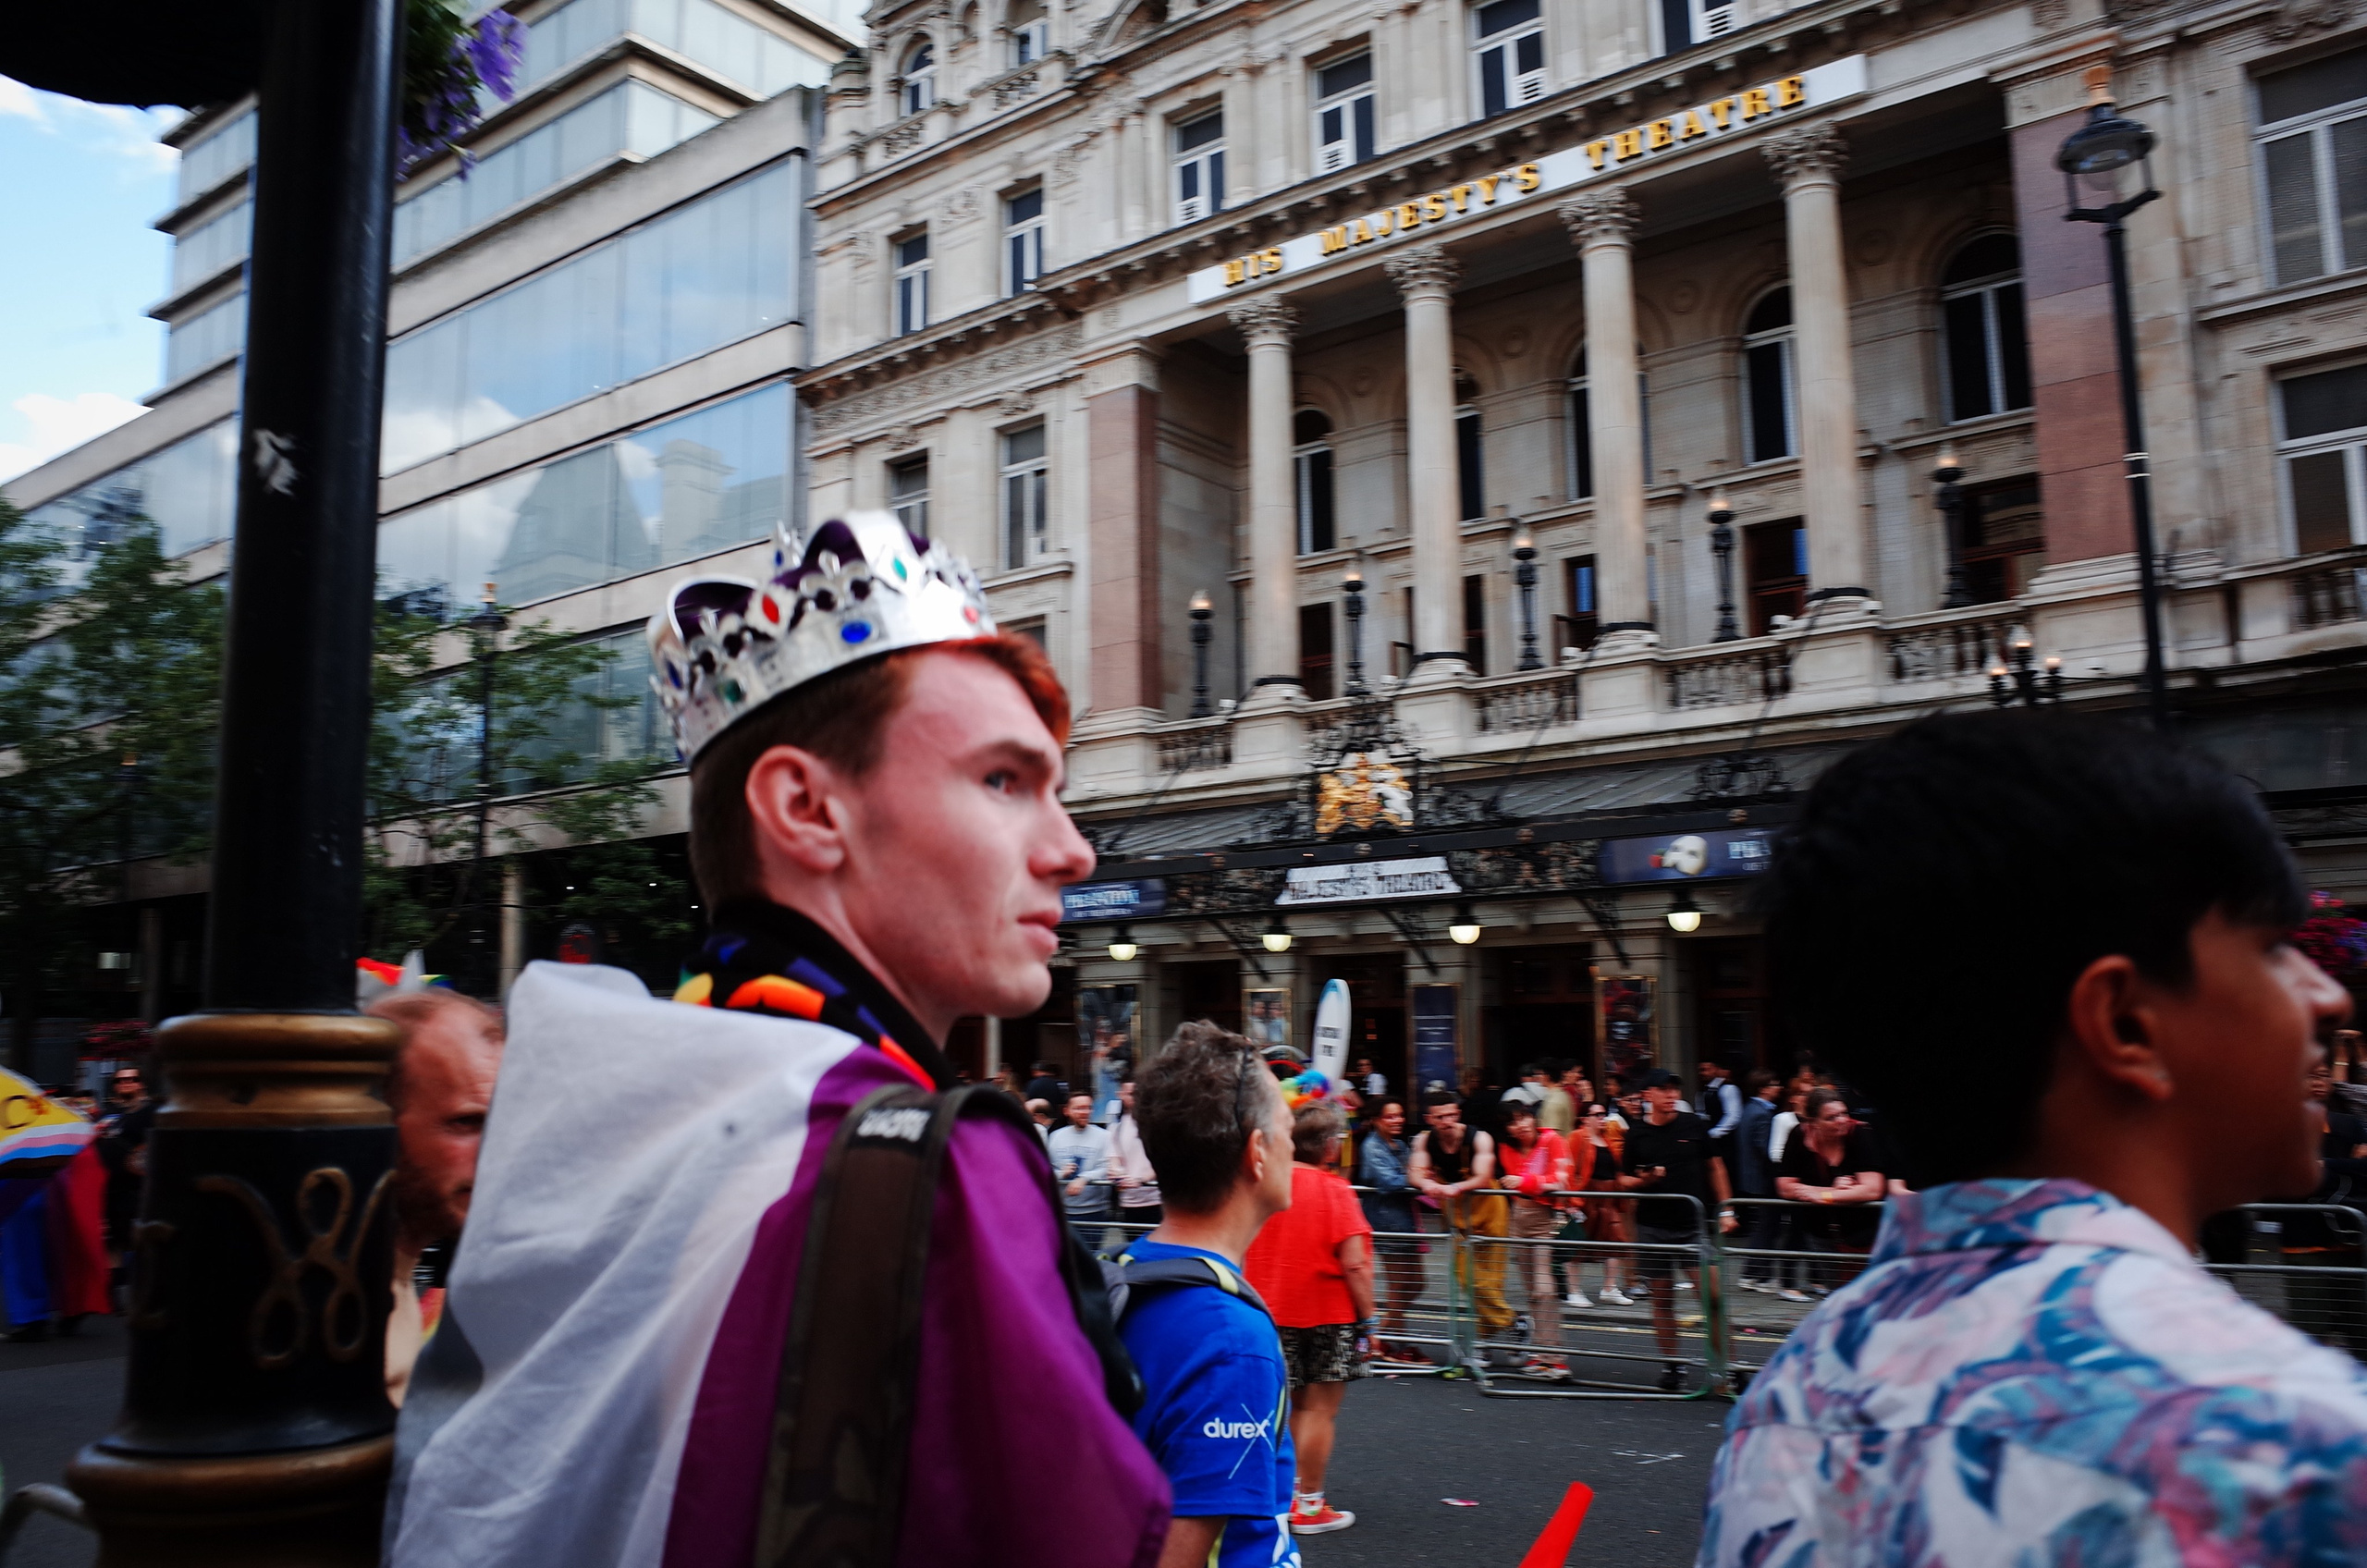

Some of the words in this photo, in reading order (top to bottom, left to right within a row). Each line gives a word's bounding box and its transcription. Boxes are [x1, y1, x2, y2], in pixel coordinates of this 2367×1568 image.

[1222, 247, 1283, 286] HIS
[1318, 163, 1541, 254] MAJESTY'S
[1585, 75, 1806, 169] THEATRE
[1203, 1417, 1270, 1439] durex
